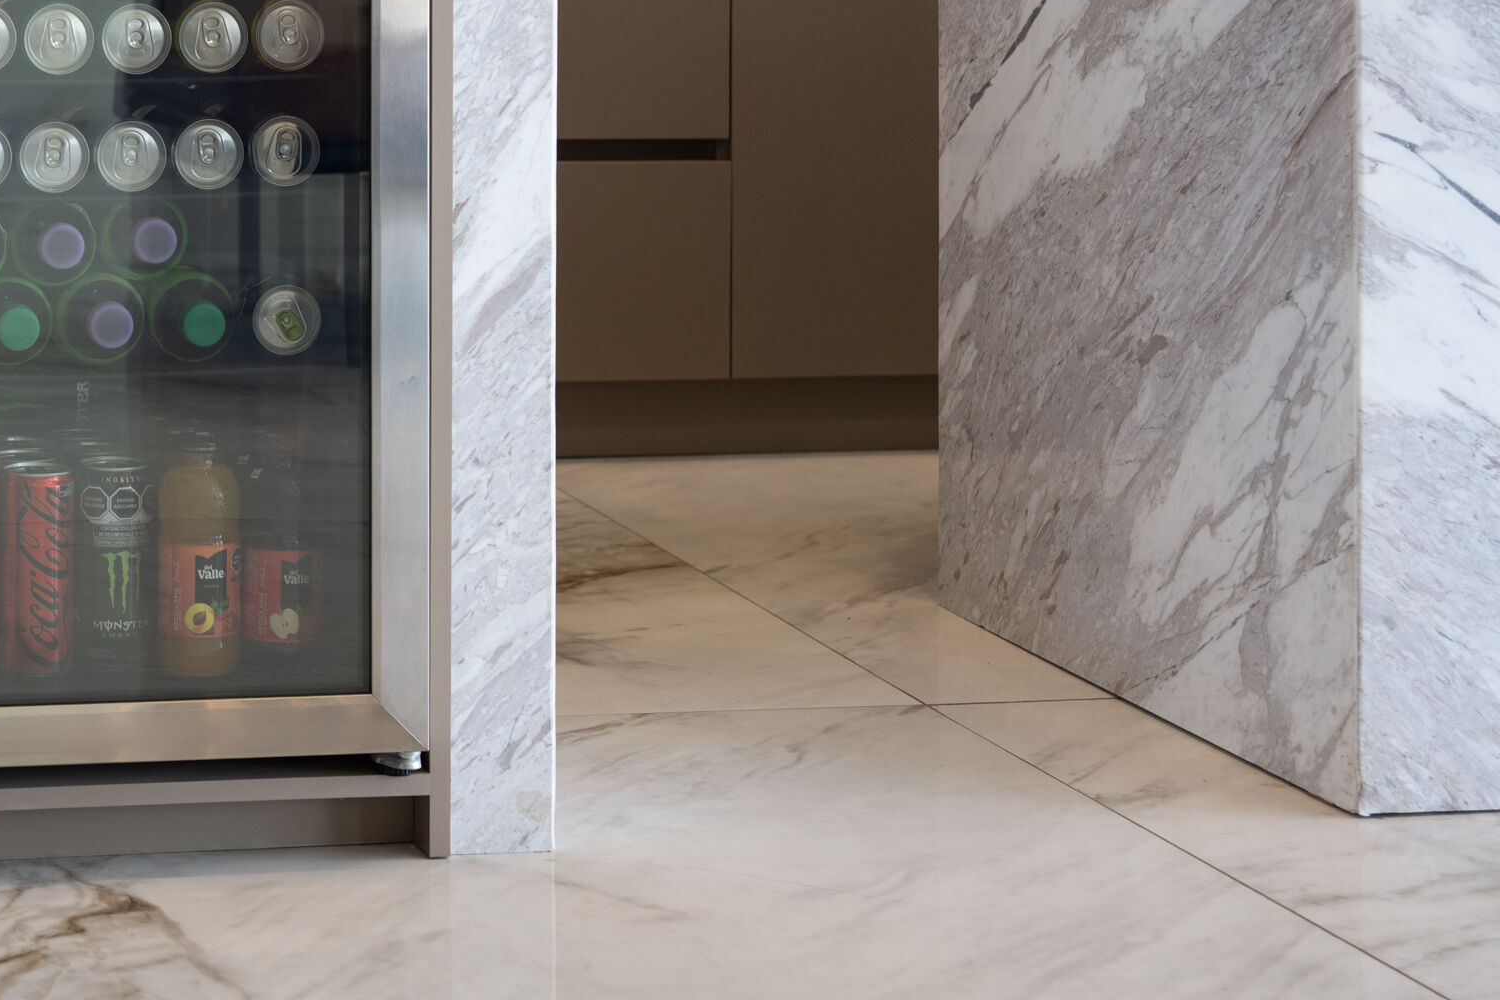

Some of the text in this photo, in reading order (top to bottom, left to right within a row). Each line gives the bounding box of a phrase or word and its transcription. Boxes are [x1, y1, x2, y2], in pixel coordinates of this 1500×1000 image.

[197, 568, 225, 580] Valle
[283, 573, 310, 585] Valle
[92, 619, 148, 632] MONSTE
